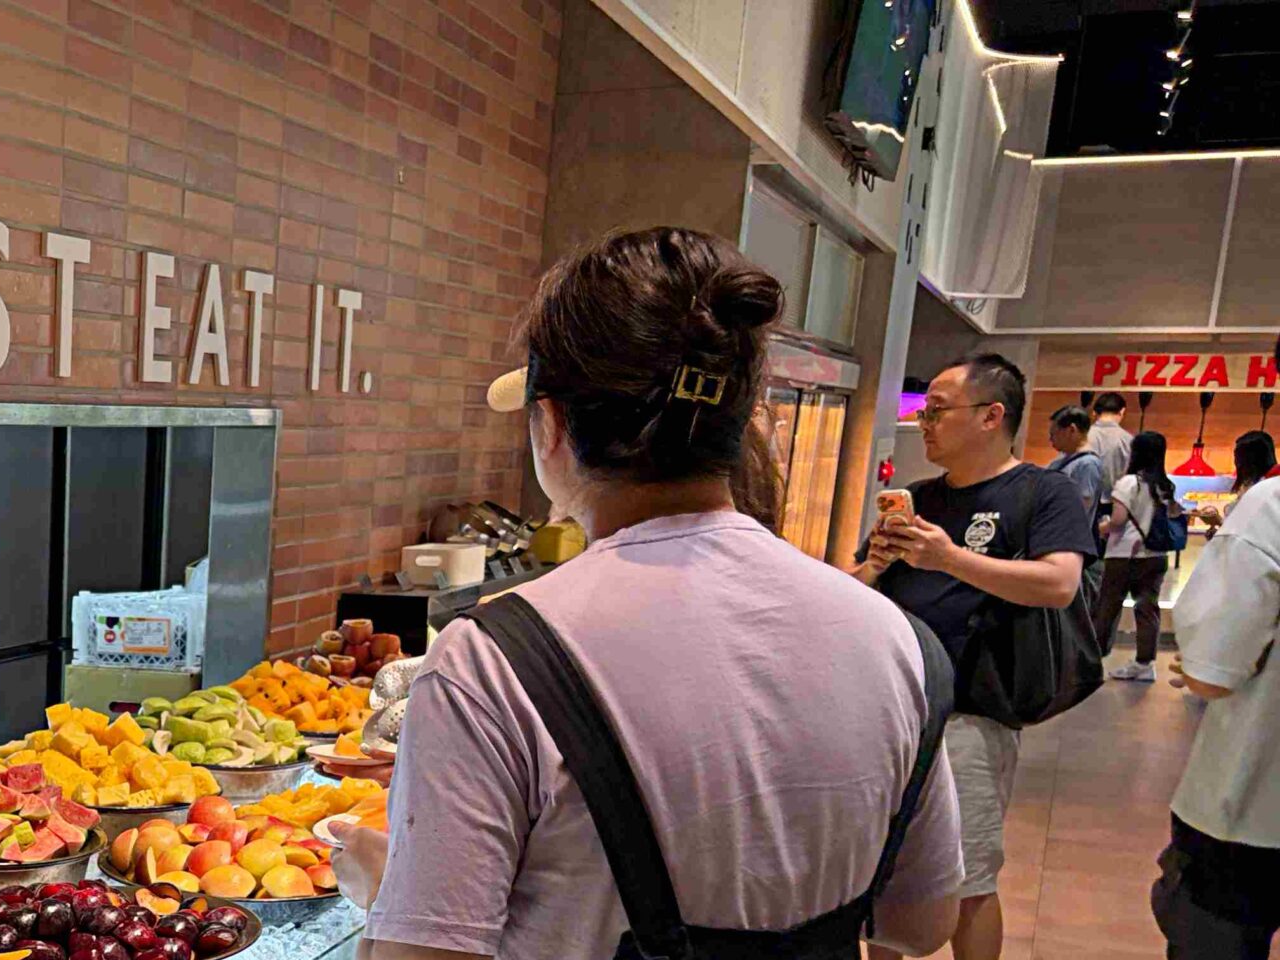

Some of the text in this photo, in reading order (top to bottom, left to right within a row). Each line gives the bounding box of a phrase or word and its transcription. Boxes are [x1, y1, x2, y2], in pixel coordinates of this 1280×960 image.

[138, 250, 275, 387] EAT
[306, 284, 372, 394] IT.
[1093, 355, 1229, 387] PIZZA
